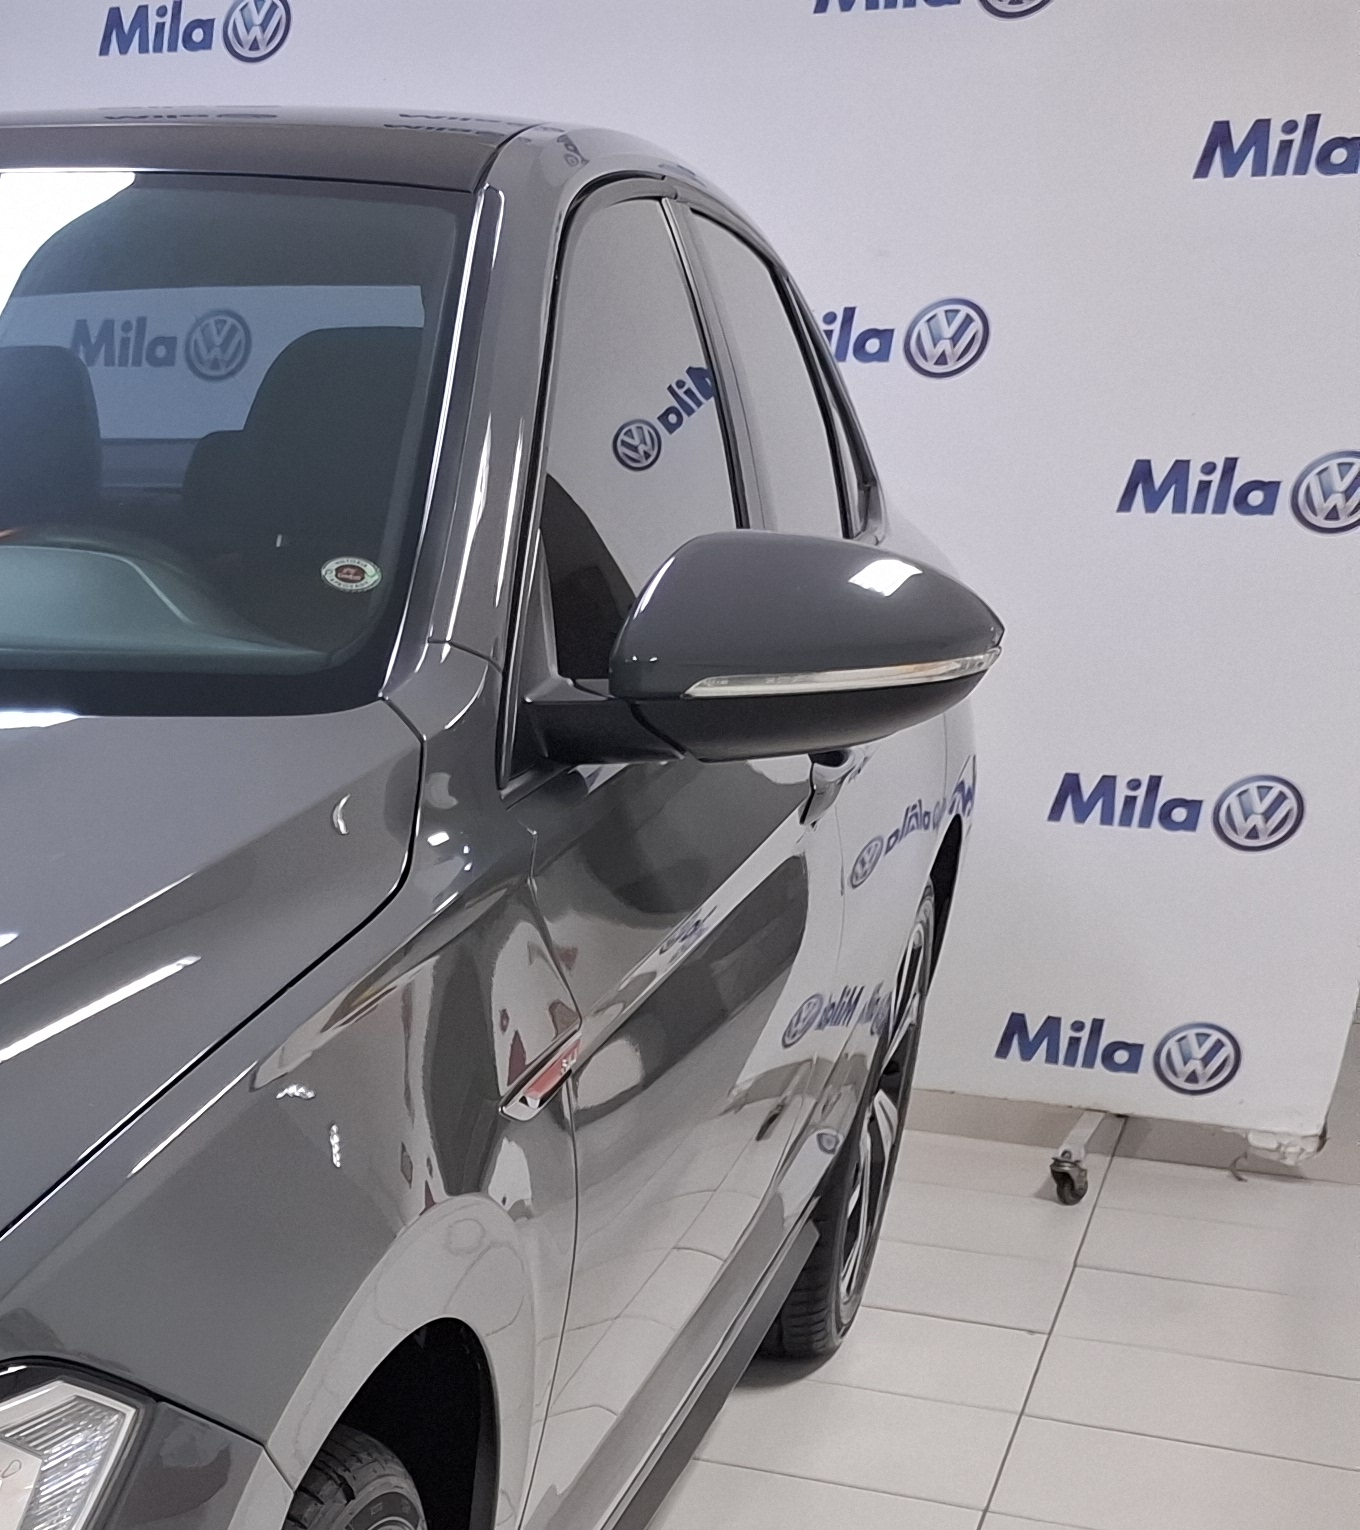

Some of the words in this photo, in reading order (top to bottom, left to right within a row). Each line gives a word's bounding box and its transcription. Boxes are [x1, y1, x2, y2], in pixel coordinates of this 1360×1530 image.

[99, 0, 215, 57] Mila
[1193, 114, 1360, 179] Mila
[70, 316, 177, 368] Mila
[1117, 457, 1281, 515] Mila
[1048, 773, 1203, 832] Mila
[995, 1012, 1144, 1074] Mila
